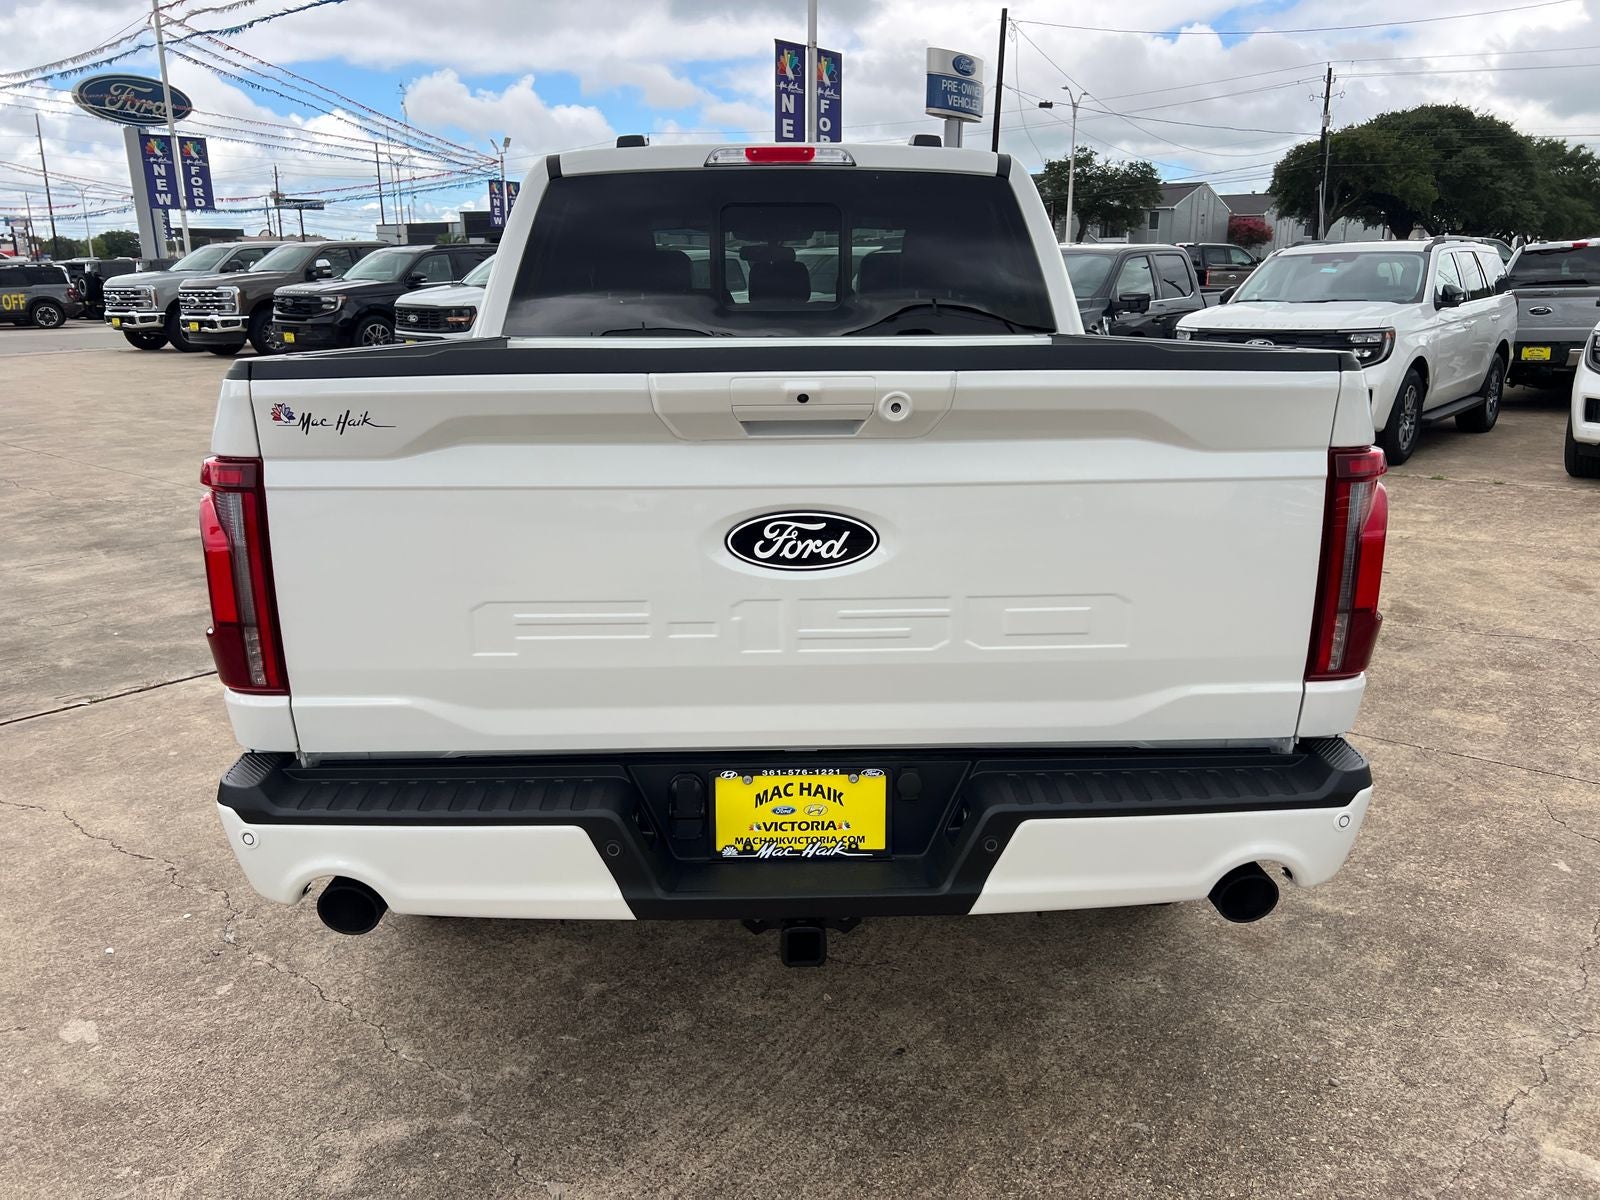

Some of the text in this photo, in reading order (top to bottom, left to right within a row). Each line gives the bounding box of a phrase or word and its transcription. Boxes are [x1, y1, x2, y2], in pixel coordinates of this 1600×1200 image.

[947, 94, 980, 111] VEHICLES
[153, 164, 172, 206] NEW
[190, 166, 206, 207] FORD
[493, 198, 502, 225] NEW
[2, 294, 26, 311] OFF
[298, 409, 383, 435] Mac Haik
[754, 521, 850, 559] Ford
[470, 593, 1132, 656] F-150
[754, 782, 844, 808] MAC HAIK
[775, 806, 793, 815] Ford
[763, 820, 837, 832] VICTORIA
[735, 835, 866, 845] MACHAIKVICTORIACOM
[756, 841, 850, 858] Mac Haik
